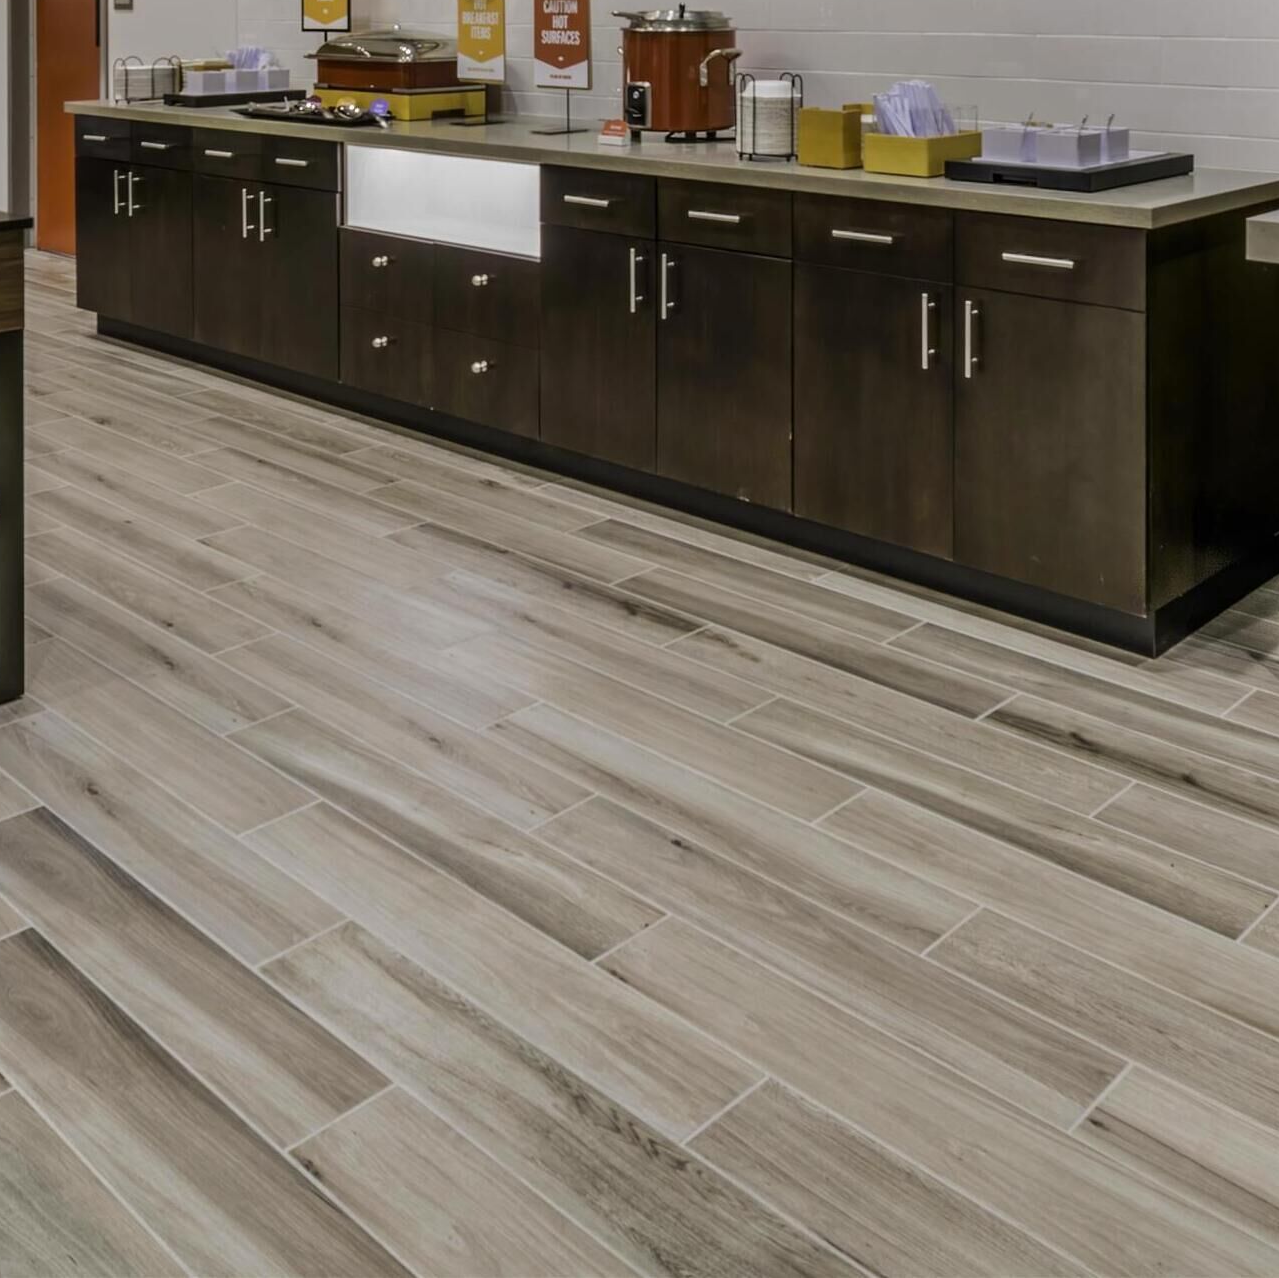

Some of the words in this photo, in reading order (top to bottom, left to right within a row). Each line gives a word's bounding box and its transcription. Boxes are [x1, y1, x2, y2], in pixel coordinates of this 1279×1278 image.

[543, 0, 578, 14] CAUTION
[552, 15, 568, 29] HOT
[541, 30, 580, 45] SURFACES
